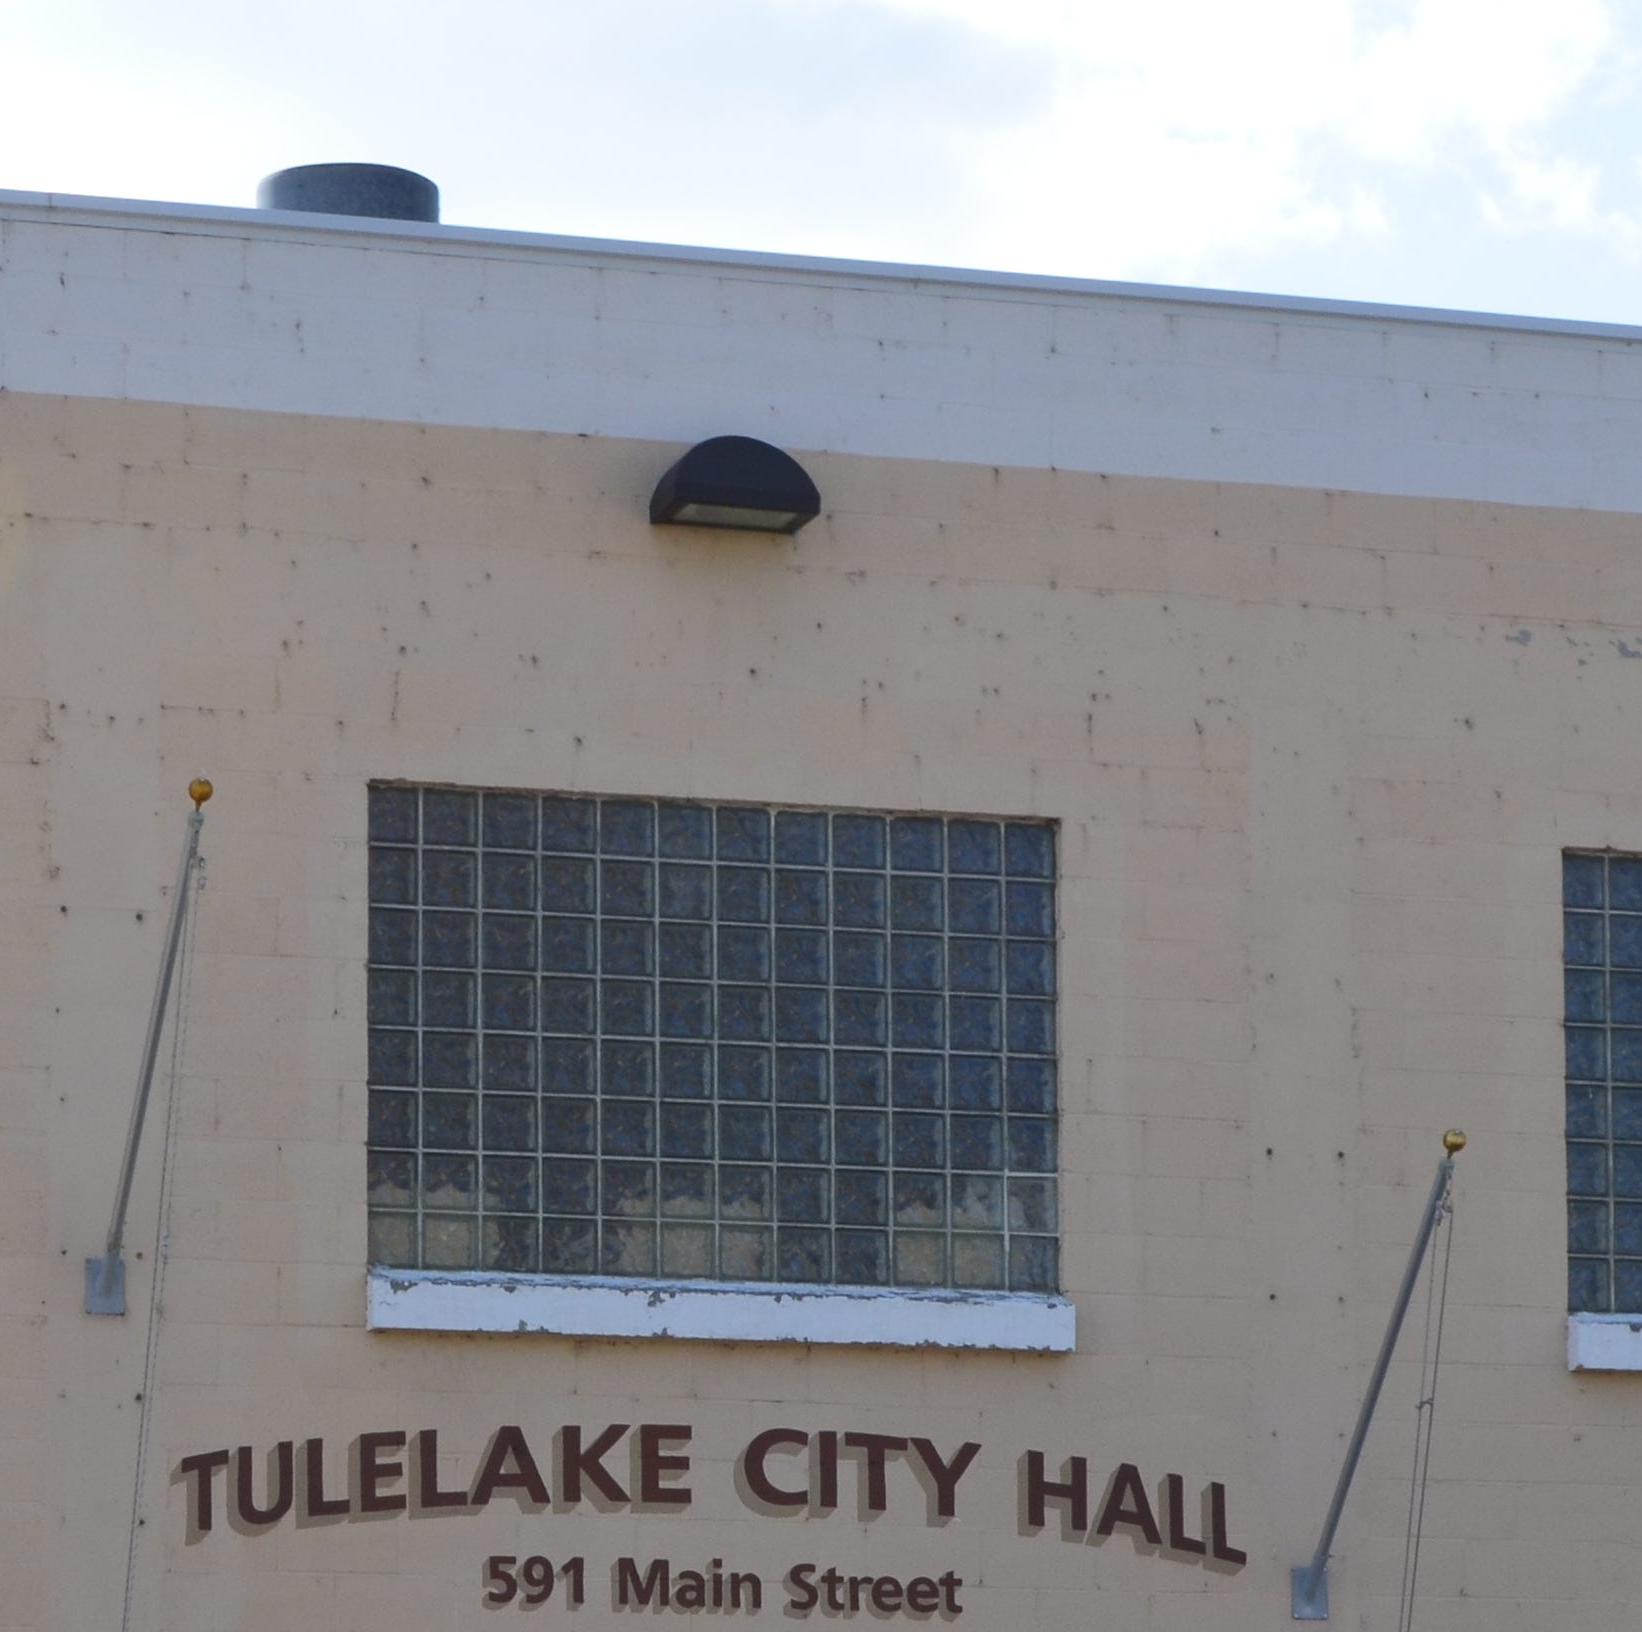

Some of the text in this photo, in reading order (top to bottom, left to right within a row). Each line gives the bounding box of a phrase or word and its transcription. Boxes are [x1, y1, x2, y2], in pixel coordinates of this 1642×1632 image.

[179, 1425, 1249, 1566] TULELAKE CITY HALL
[485, 1556, 964, 1615] 591 Main Street
